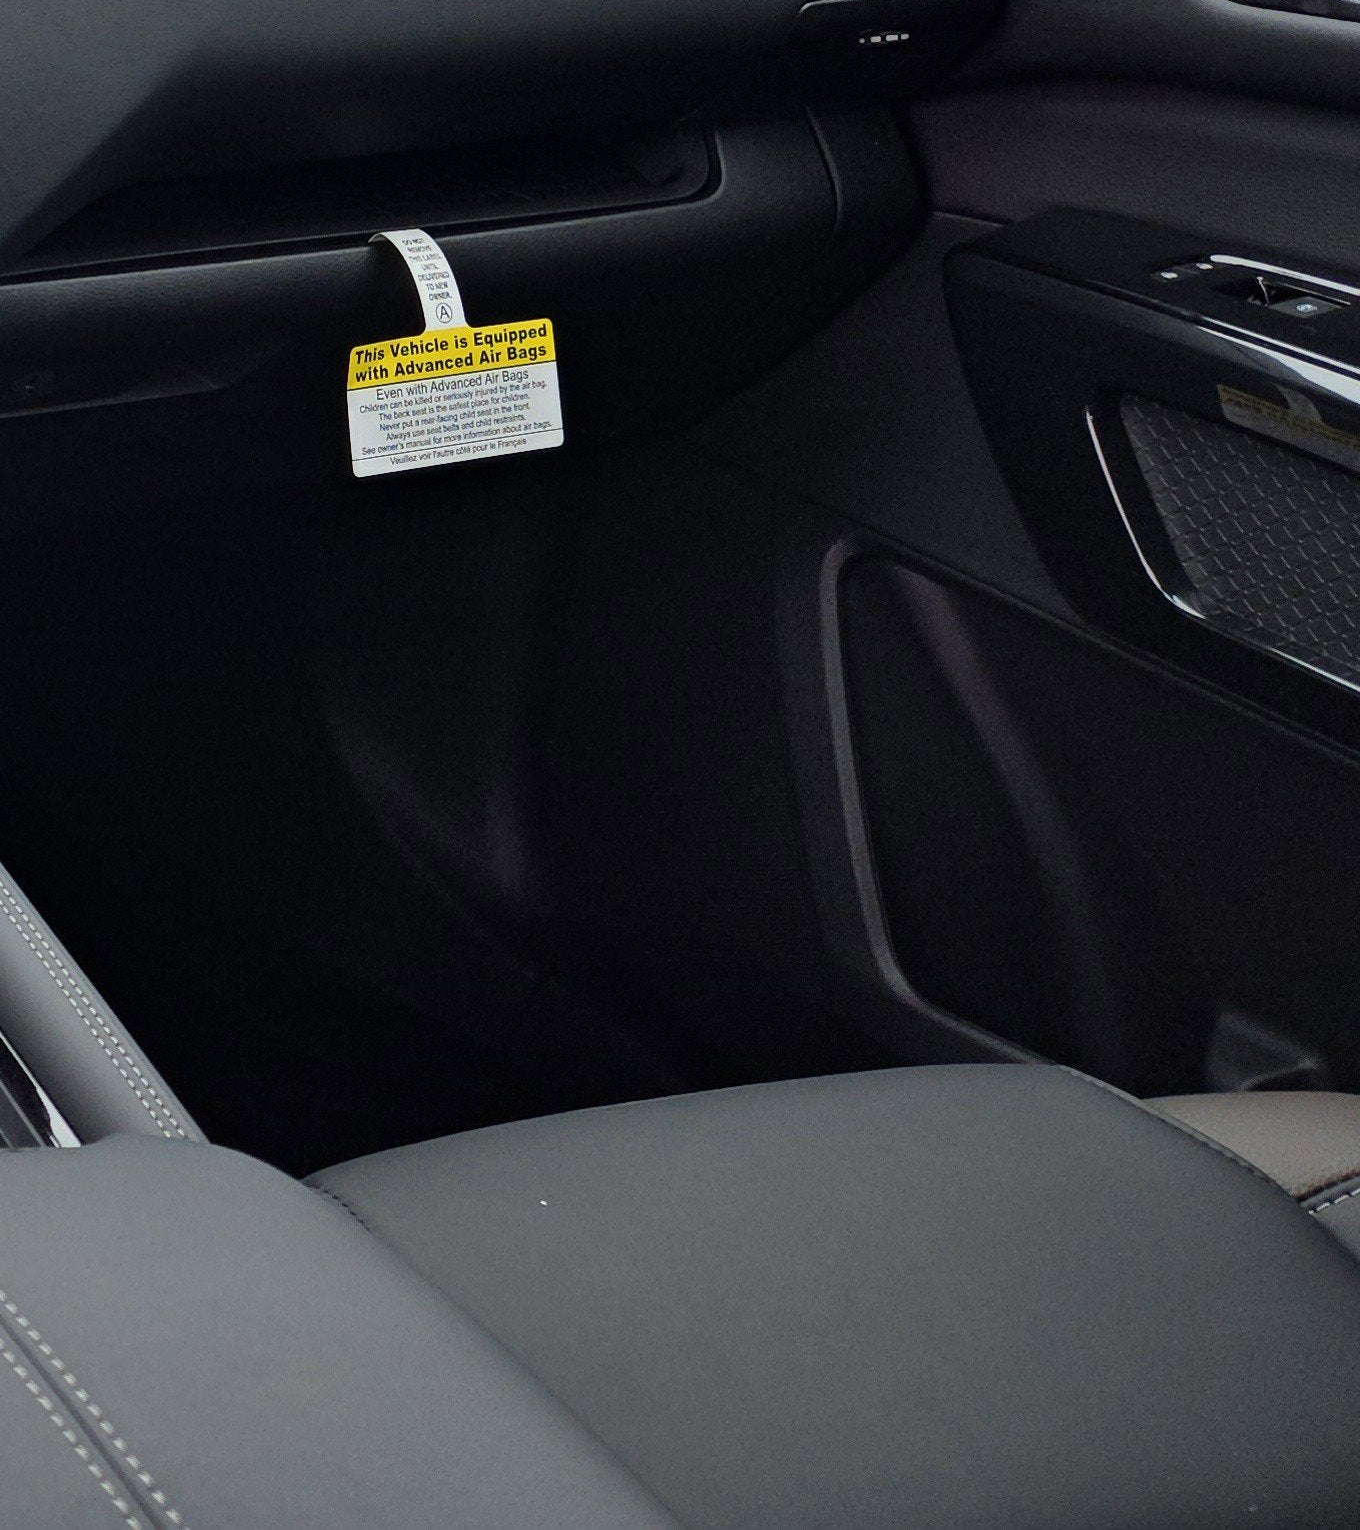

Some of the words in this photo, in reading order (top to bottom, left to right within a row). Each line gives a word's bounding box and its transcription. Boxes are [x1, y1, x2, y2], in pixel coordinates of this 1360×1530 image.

[417, 271, 450, 282] DELIVERED
[439, 305, 450, 319] A
[355, 347, 385, 364] This
[389, 338, 449, 358] Vehicle
[454, 336, 468, 349] is
[473, 323, 547, 348] Equipped
[355, 365, 389, 382] with
[394, 353, 474, 377] Advanced
[479, 349, 502, 365] Air
[507, 345, 547, 361] Bags
[360, 403, 389, 414] Children
[404, 399, 413, 407] be
[414, 395, 433, 406] killed
[443, 390, 474, 401] seriously
[475, 386, 498, 398] injured
[499, 385, 508, 394] by
[509, 383, 520, 391] the
[376, 387, 403, 401] Even
[406, 383, 428, 396] with
[430, 375, 482, 393] Advanced
[484, 373, 499, 386] Air
[502, 370, 529, 383] Bags
[378, 413, 392, 421] The
[393, 411, 411, 419] back
[412, 408, 427, 416] seat
[428, 406, 435, 414] is
[436, 404, 448, 412] the
[449, 401, 469, 411] safest
[470, 399, 489, 409] place
[491, 396, 500, 404] for
[379, 423, 400, 432] Never
[402, 419, 413, 430] put
[459, 410, 476, 420] child
[477, 408, 492, 417] seat
[501, 405, 512, 413] the
[361, 446, 376, 456] See
[377, 442, 405, 453] owner's
[406, 438, 431, 449] manual
[433, 436, 442, 444] for
[443, 432, 461, 443] more
[463, 428, 501, 440] information
[502, 424, 522, 434] about
[523, 423, 532, 431] air
[386, 431, 411, 442] Always
[412, 429, 425, 437] use
[427, 426, 442, 435] seat
[443, 423, 460, 433] belts
[461, 420, 474, 430] and
[475, 418, 492, 428] child
[389, 455, 418, 465] Veuillez
[419, 452, 432, 461] voir
[472, 443, 488, 454] pour
[489, 441, 497, 449] le
[498, 437, 527, 448] Français
